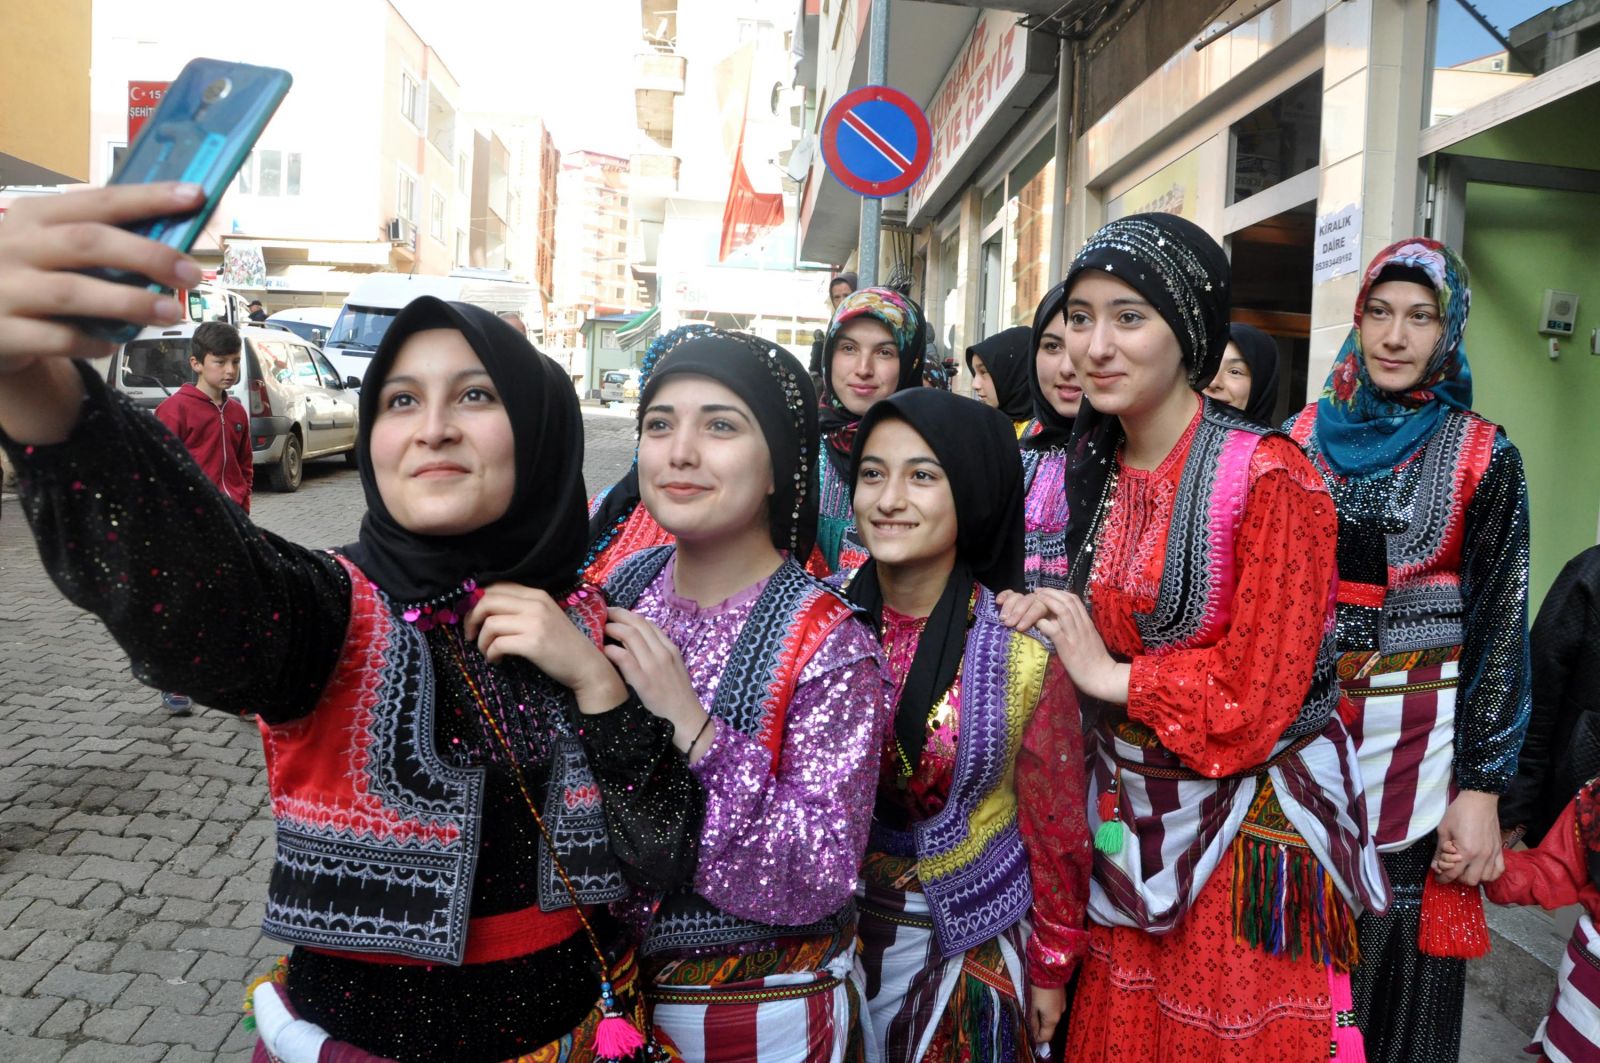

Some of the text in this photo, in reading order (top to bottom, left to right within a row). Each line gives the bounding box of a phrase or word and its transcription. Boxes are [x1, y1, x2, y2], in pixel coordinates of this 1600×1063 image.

[148, 90, 161, 99] 15
[946, 107, 962, 159] VE
[965, 24, 1015, 142] ÇEYİZ
[129, 105, 154, 119] ŞEHİT
[1319, 215, 1352, 236] KİRALIK
[1322, 237, 1345, 254] DAİRE
